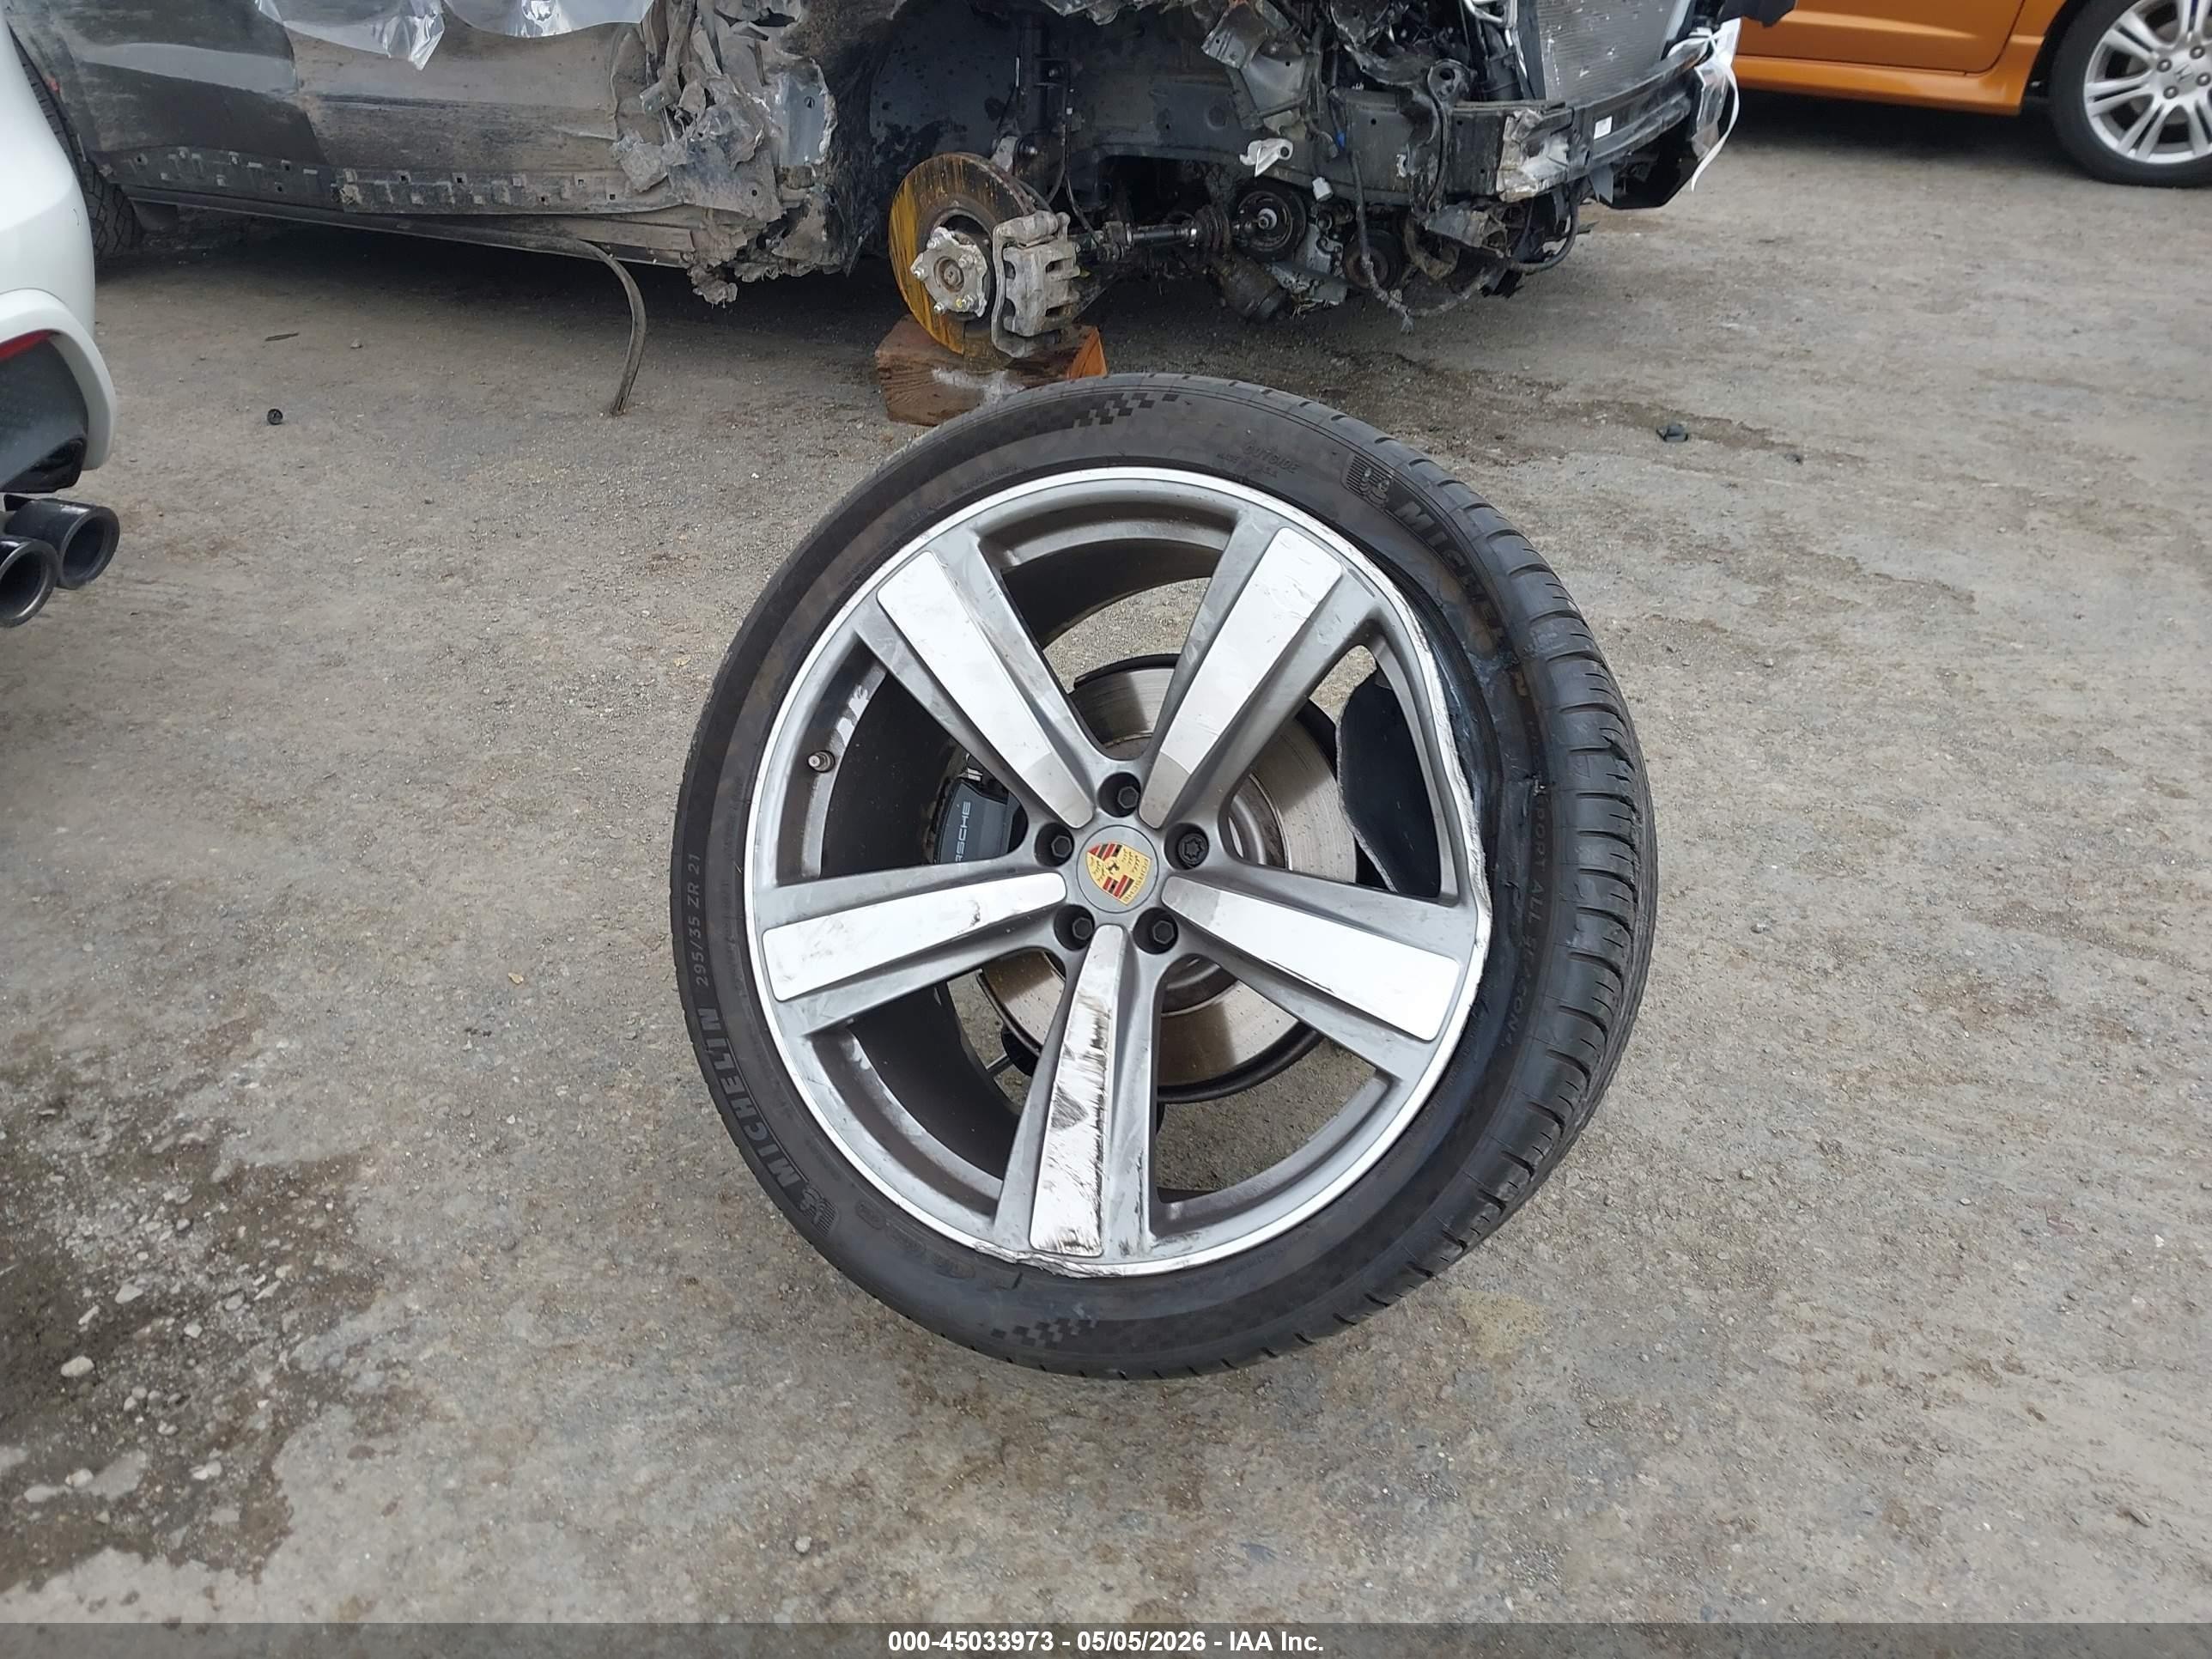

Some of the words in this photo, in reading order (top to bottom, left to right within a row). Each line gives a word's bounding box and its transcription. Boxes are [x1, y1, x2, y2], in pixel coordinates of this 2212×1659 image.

[1394, 501, 1529, 698] MICHELN
[1527, 880, 1544, 926] ALL
[955, 800, 971, 862] RSCHE
[687, 881, 702, 906] ZR
[688, 854, 701, 874] 21
[1124, 858, 1149, 902] PORSCHE
[685, 913, 708, 988] 295/35
[700, 1008, 800, 1190] MICHELIN
